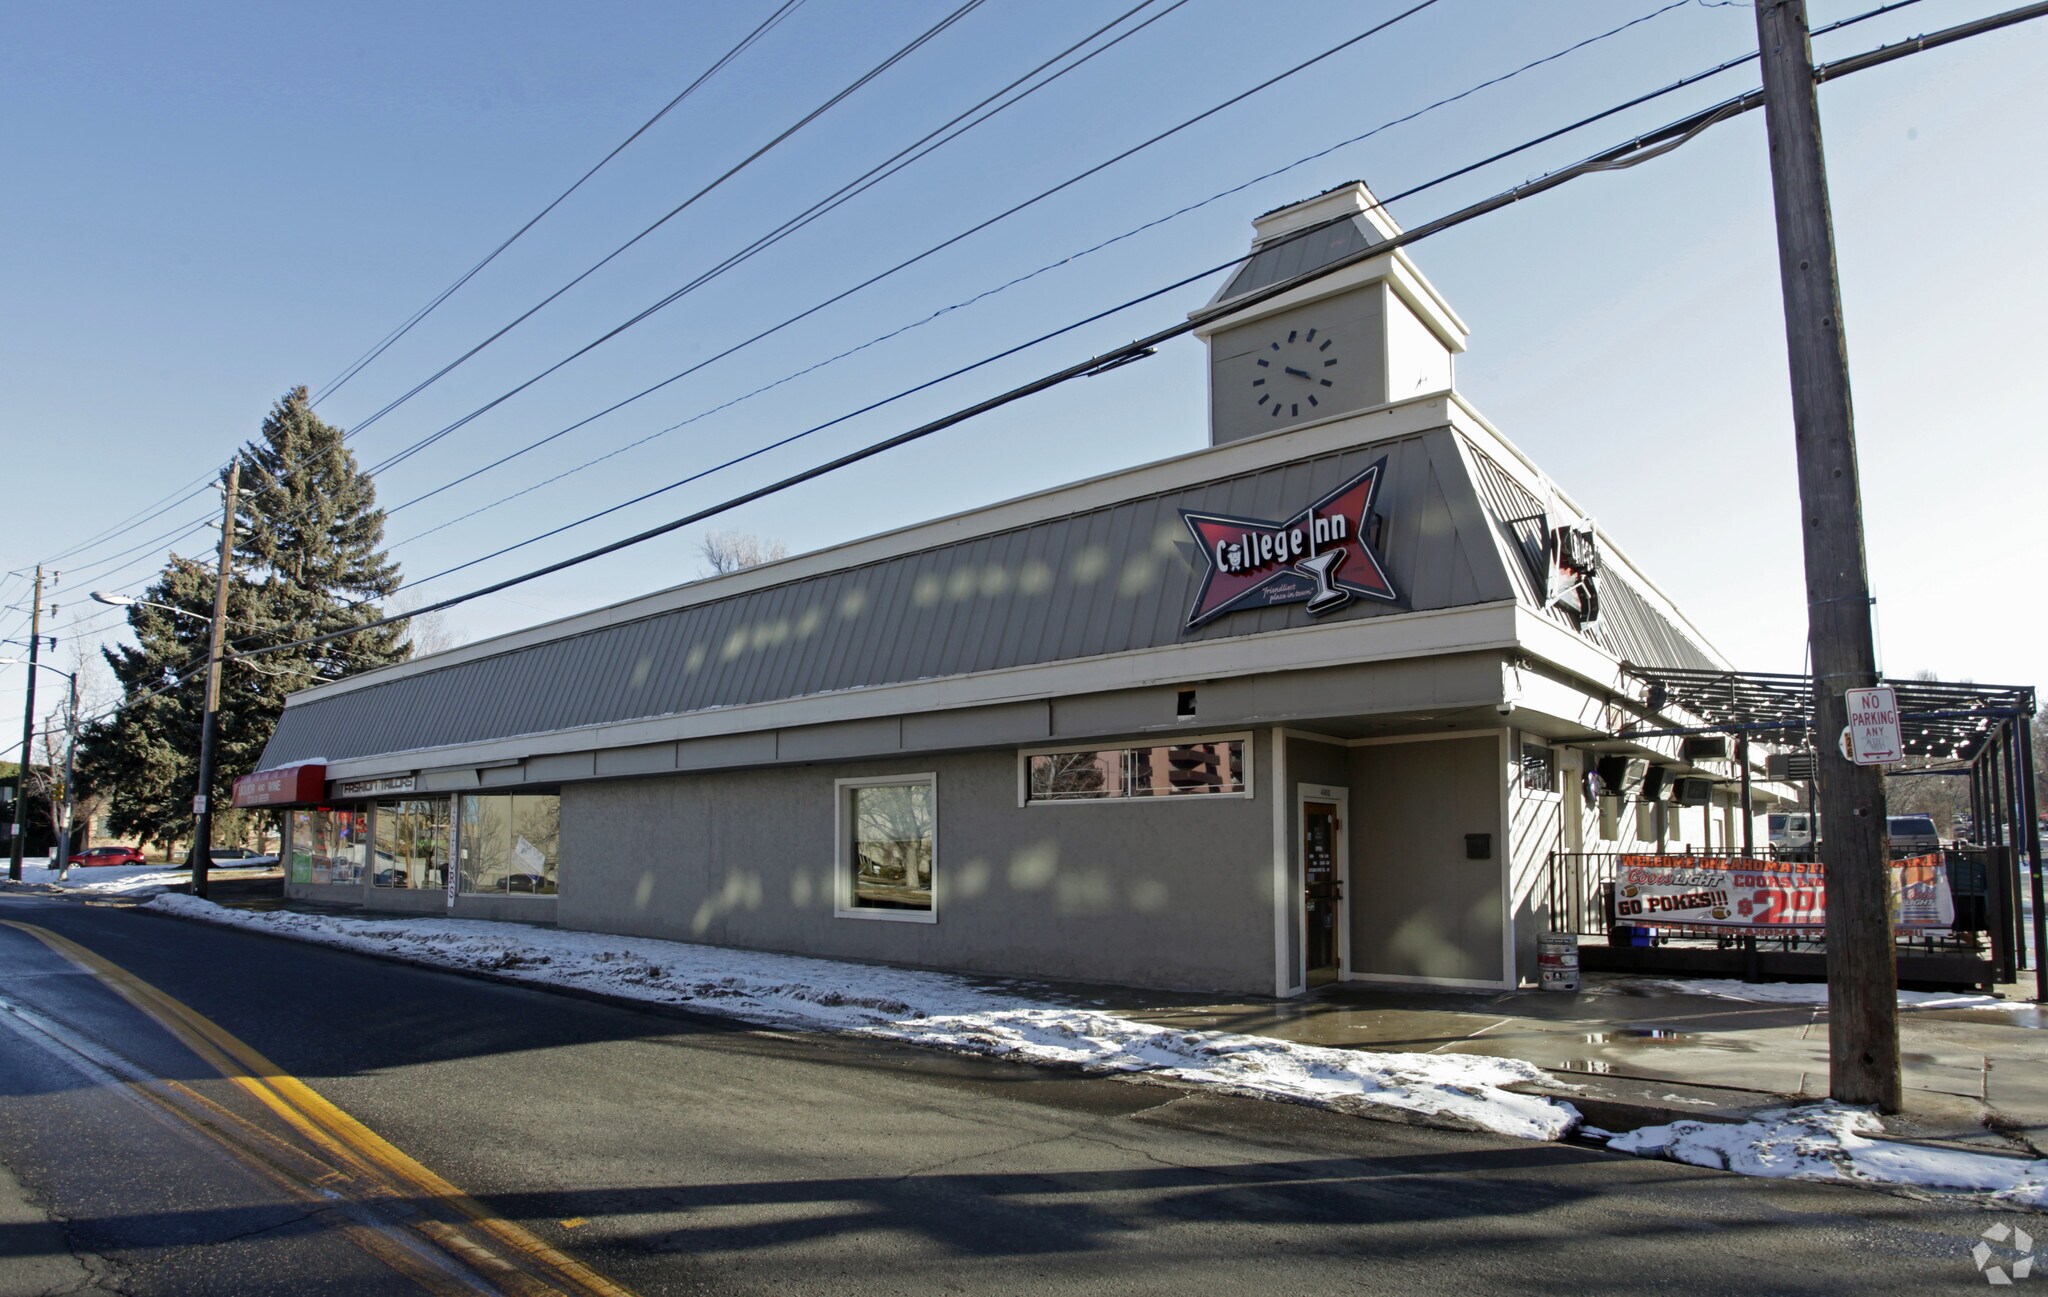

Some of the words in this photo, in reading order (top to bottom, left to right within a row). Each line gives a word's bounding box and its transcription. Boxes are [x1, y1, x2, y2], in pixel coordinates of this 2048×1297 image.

[1308, 507, 1347, 560] Inn
[1269, 593, 1287, 604] place
[1287, 591, 1295, 599] in
[1861, 695, 1880, 709] NO
[1852, 710, 1894, 726] PARKING
[1866, 726, 1884, 737] ANY
[1621, 855, 1695, 868] WELCOME
[1699, 857, 1792, 874] OKLAHOMA
[1628, 866, 1673, 886] Coors
[1672, 873, 1725, 888] LIGHT
[1734, 874, 1792, 888] COORS
[1618, 899, 1643, 916] GO
[1647, 890, 1729, 913] POKES!!!
[1717, 927, 1798, 937] OKLAHOMA
